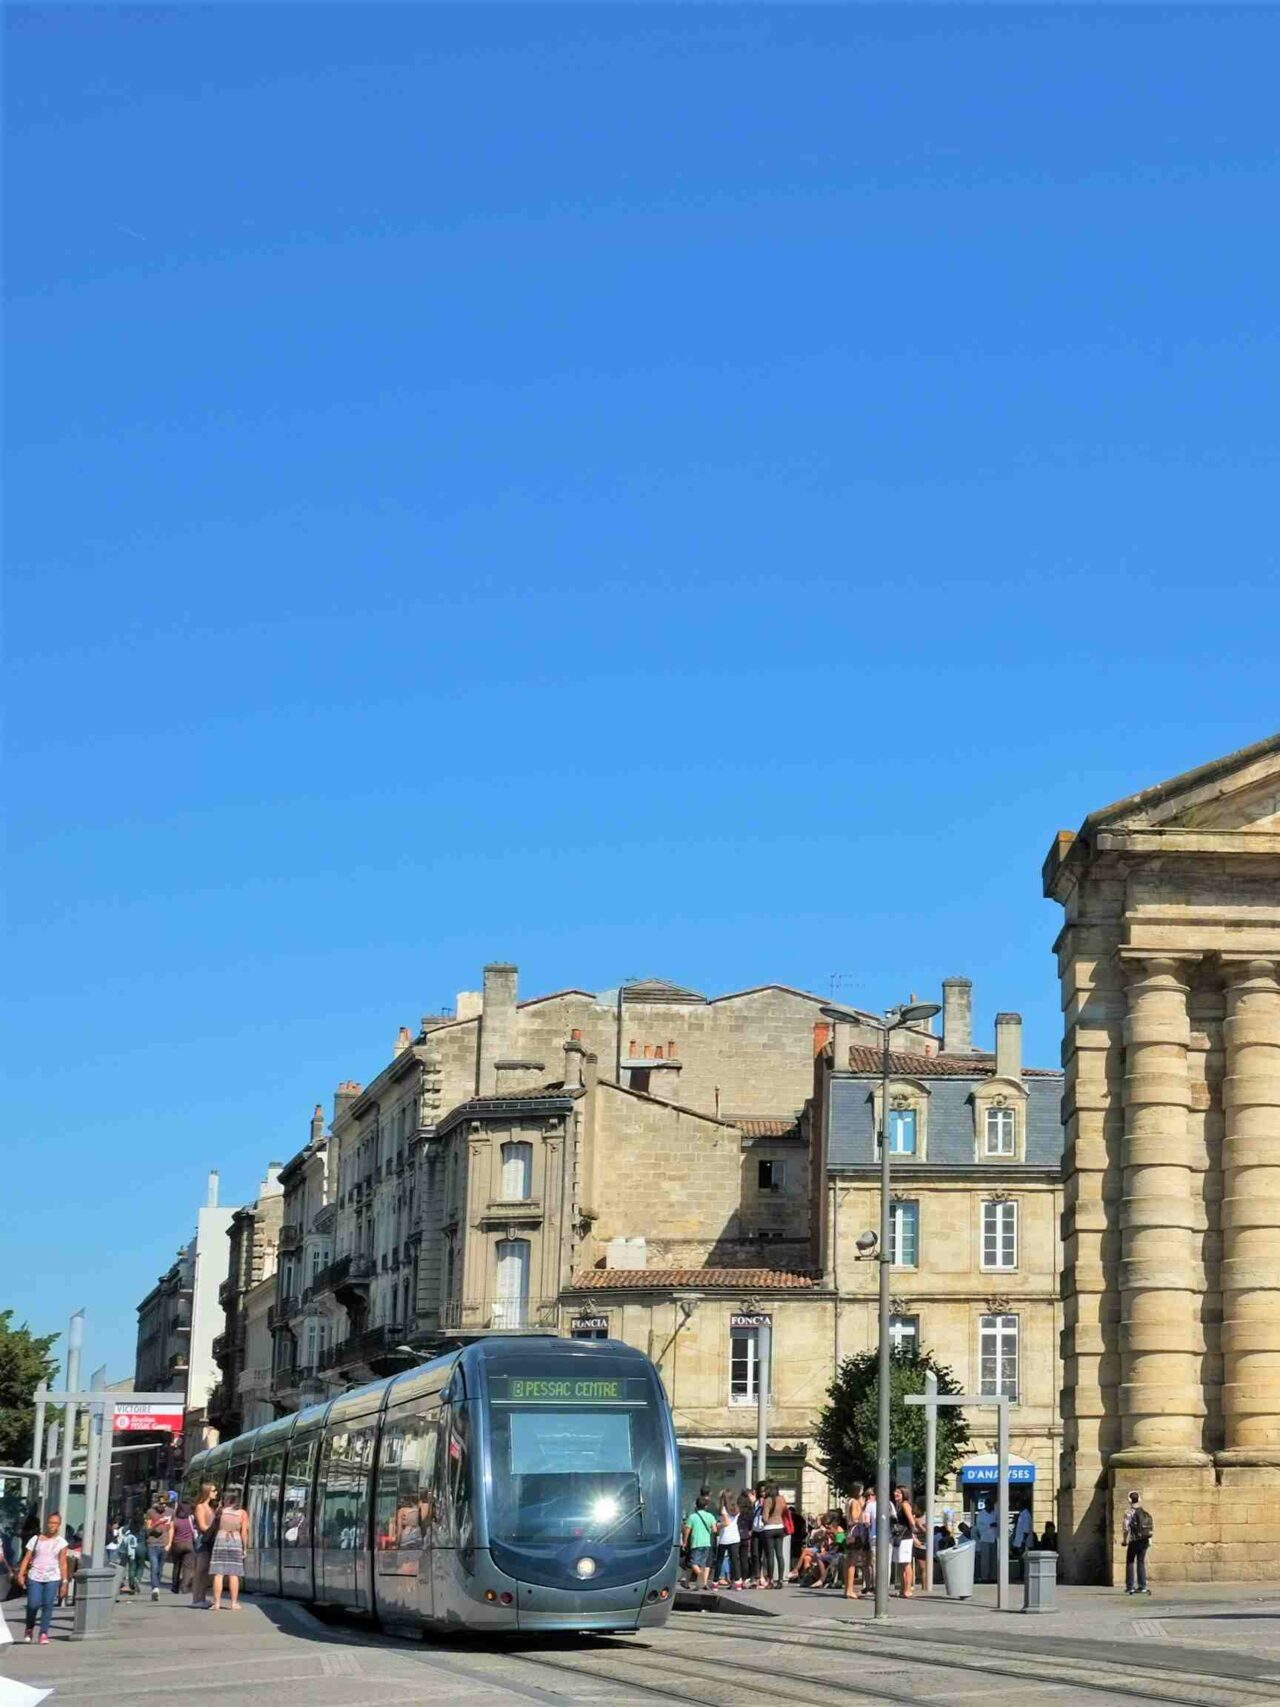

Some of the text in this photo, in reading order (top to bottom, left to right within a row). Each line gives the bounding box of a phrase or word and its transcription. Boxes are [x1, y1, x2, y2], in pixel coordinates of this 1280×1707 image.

[571, 1319, 608, 1328] FONCIA
[526, 1381, 571, 1397] PESSAC
[575, 1381, 618, 1397] CENTRE
[117, 1404, 152, 1413] VICTOIRE
[967, 1470, 1030, 1479] D'ANAYSES
